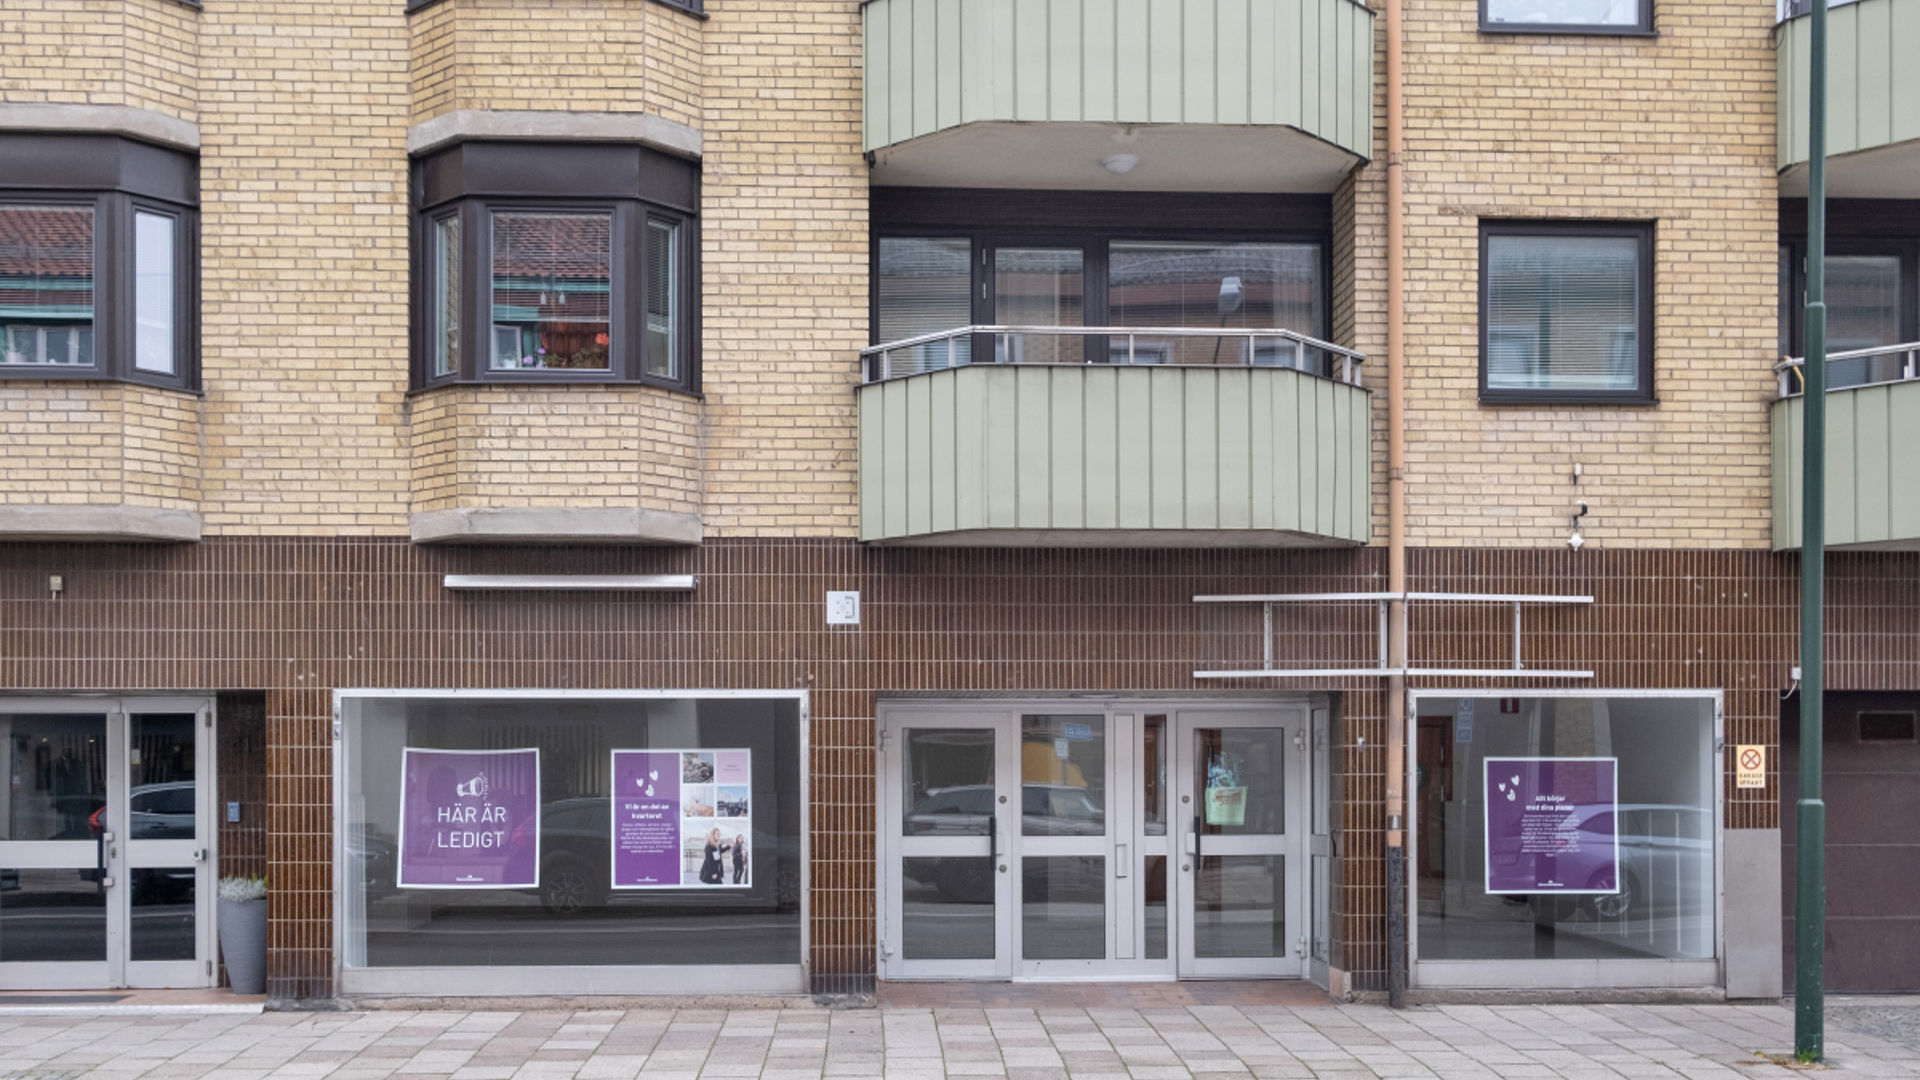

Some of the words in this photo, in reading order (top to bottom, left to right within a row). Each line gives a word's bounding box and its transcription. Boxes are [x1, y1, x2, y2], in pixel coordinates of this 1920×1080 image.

[438, 803, 477, 823] HÄR
[481, 803, 507, 823] ÄR
[438, 832, 505, 848] LEDIGT
